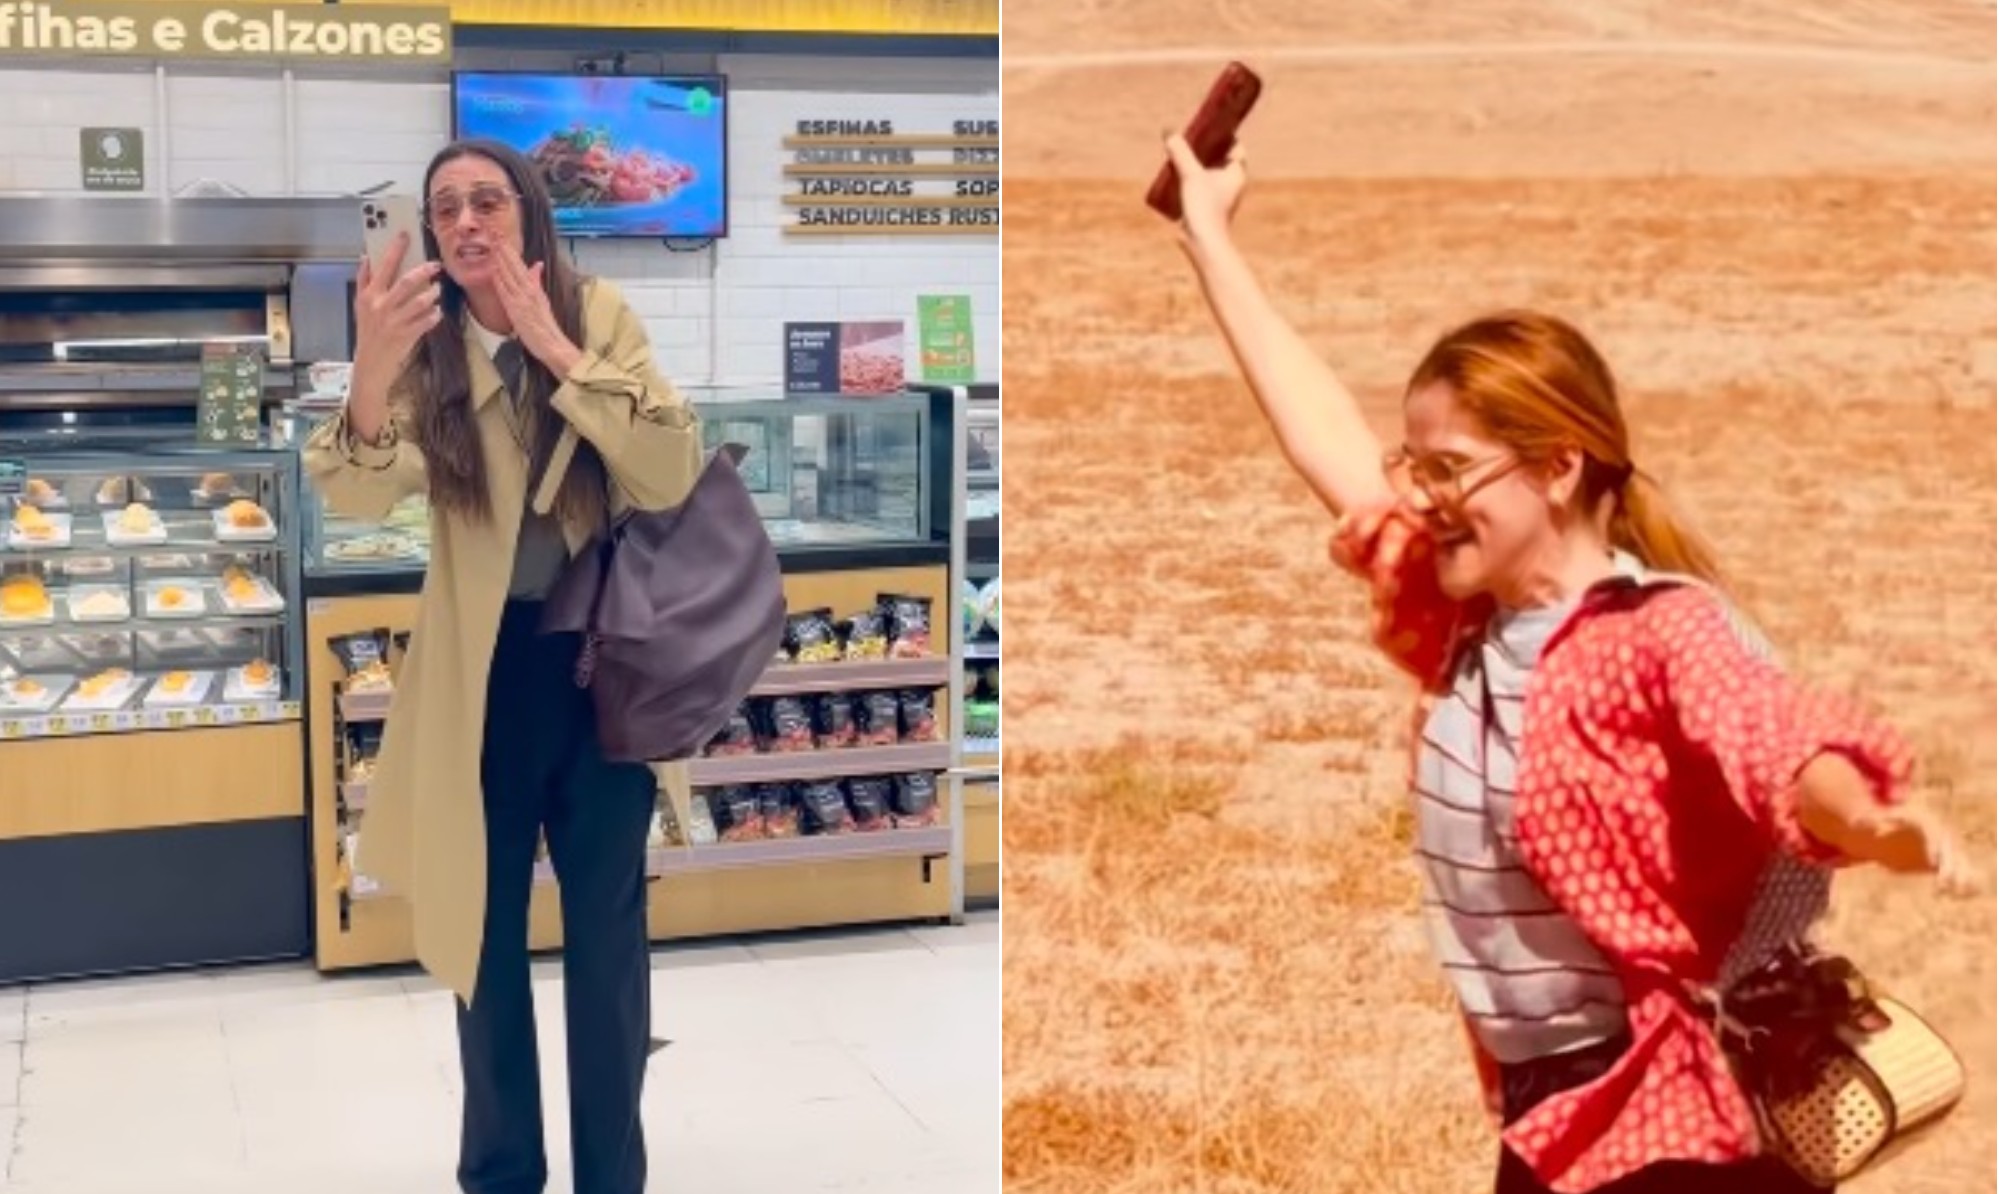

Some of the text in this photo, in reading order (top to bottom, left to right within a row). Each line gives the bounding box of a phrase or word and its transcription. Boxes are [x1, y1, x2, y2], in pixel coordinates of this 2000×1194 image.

[0, 1, 444, 55] fihas e Calzones
[800, 180, 911, 195] TAPIOCAS
[799, 208, 941, 225] SANDUICHES
